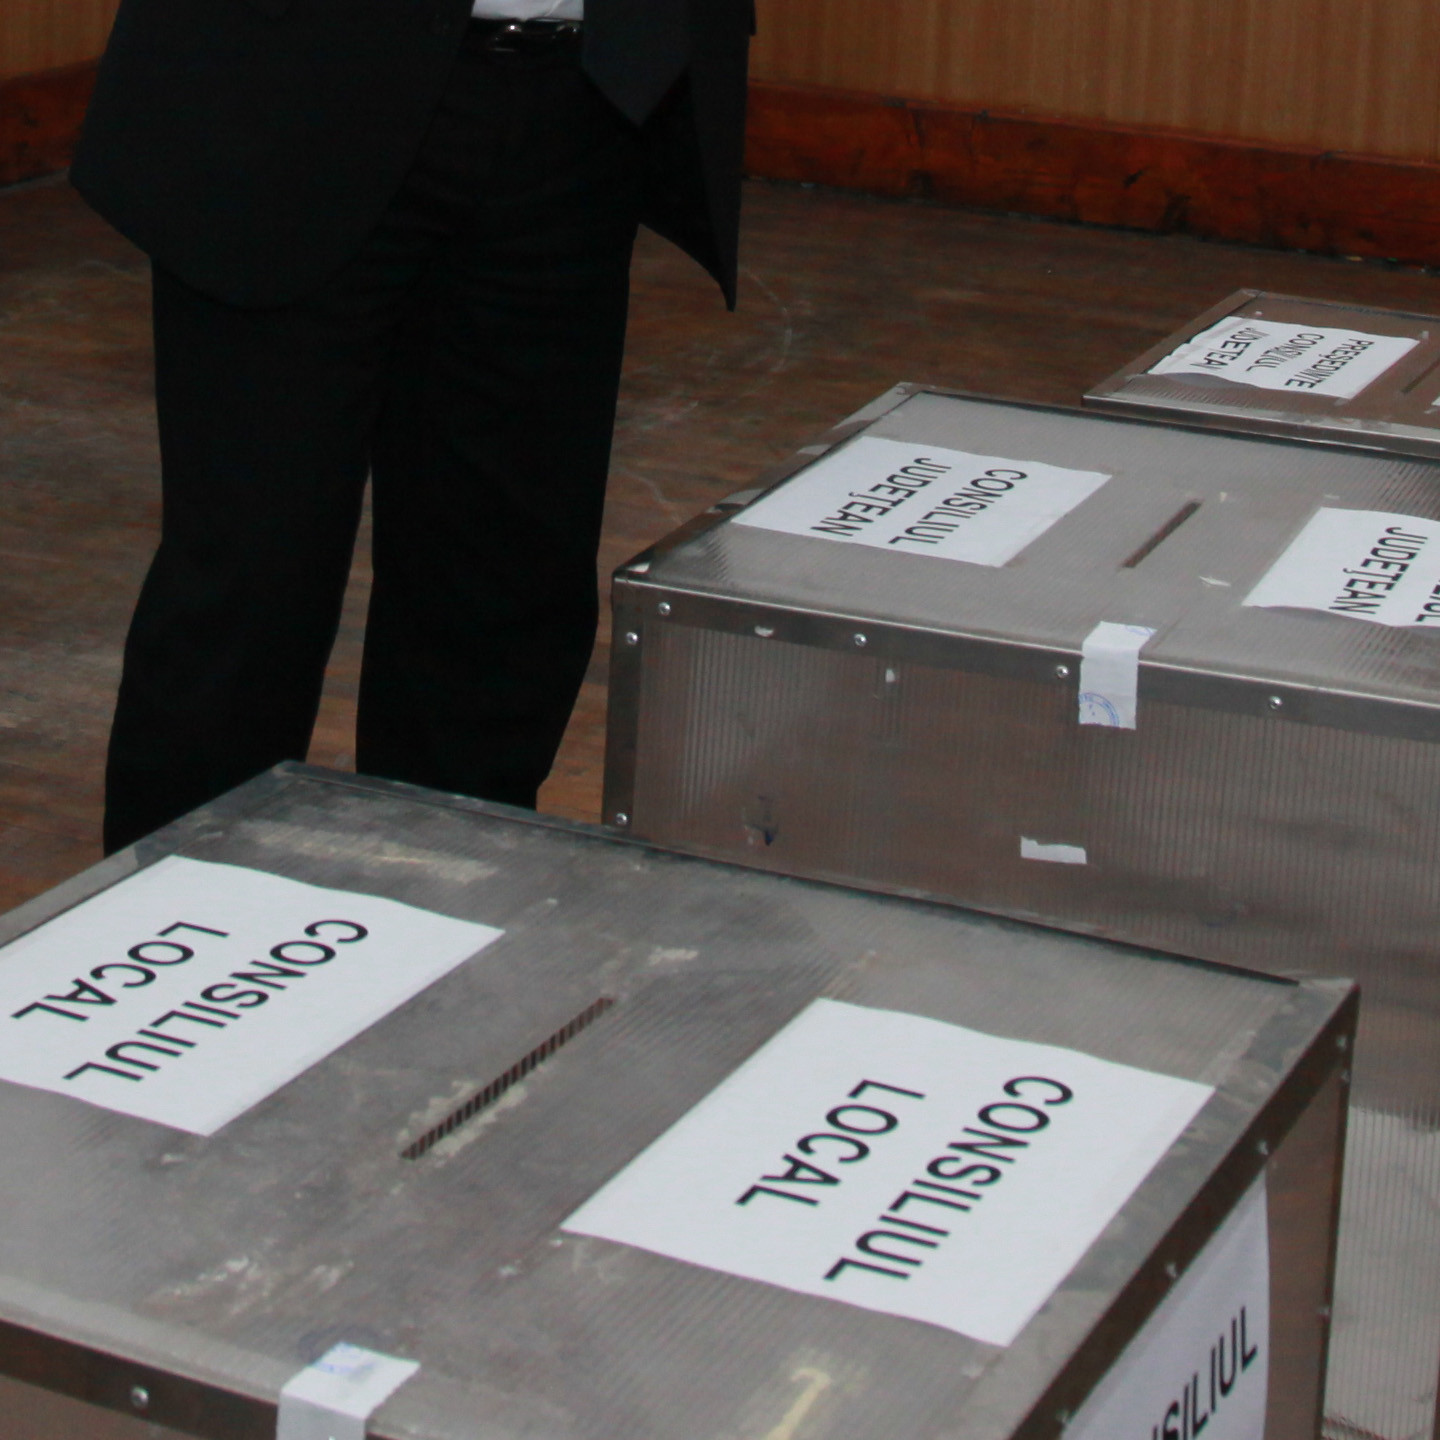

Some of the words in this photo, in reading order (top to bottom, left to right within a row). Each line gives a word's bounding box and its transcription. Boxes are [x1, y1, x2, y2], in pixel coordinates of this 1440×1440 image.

[1245, 332, 1326, 373] CONSILIUL
[888, 467, 1029, 546] CONSILIUL
[10, 921, 231, 1023] LOCAL
[63, 918, 369, 1082] CONSILIUL
[734, 1078, 927, 1208] LOCAL
[822, 1074, 1075, 1282] CONSILIUL
[1152, 1305, 1258, 1440] SILIUL
